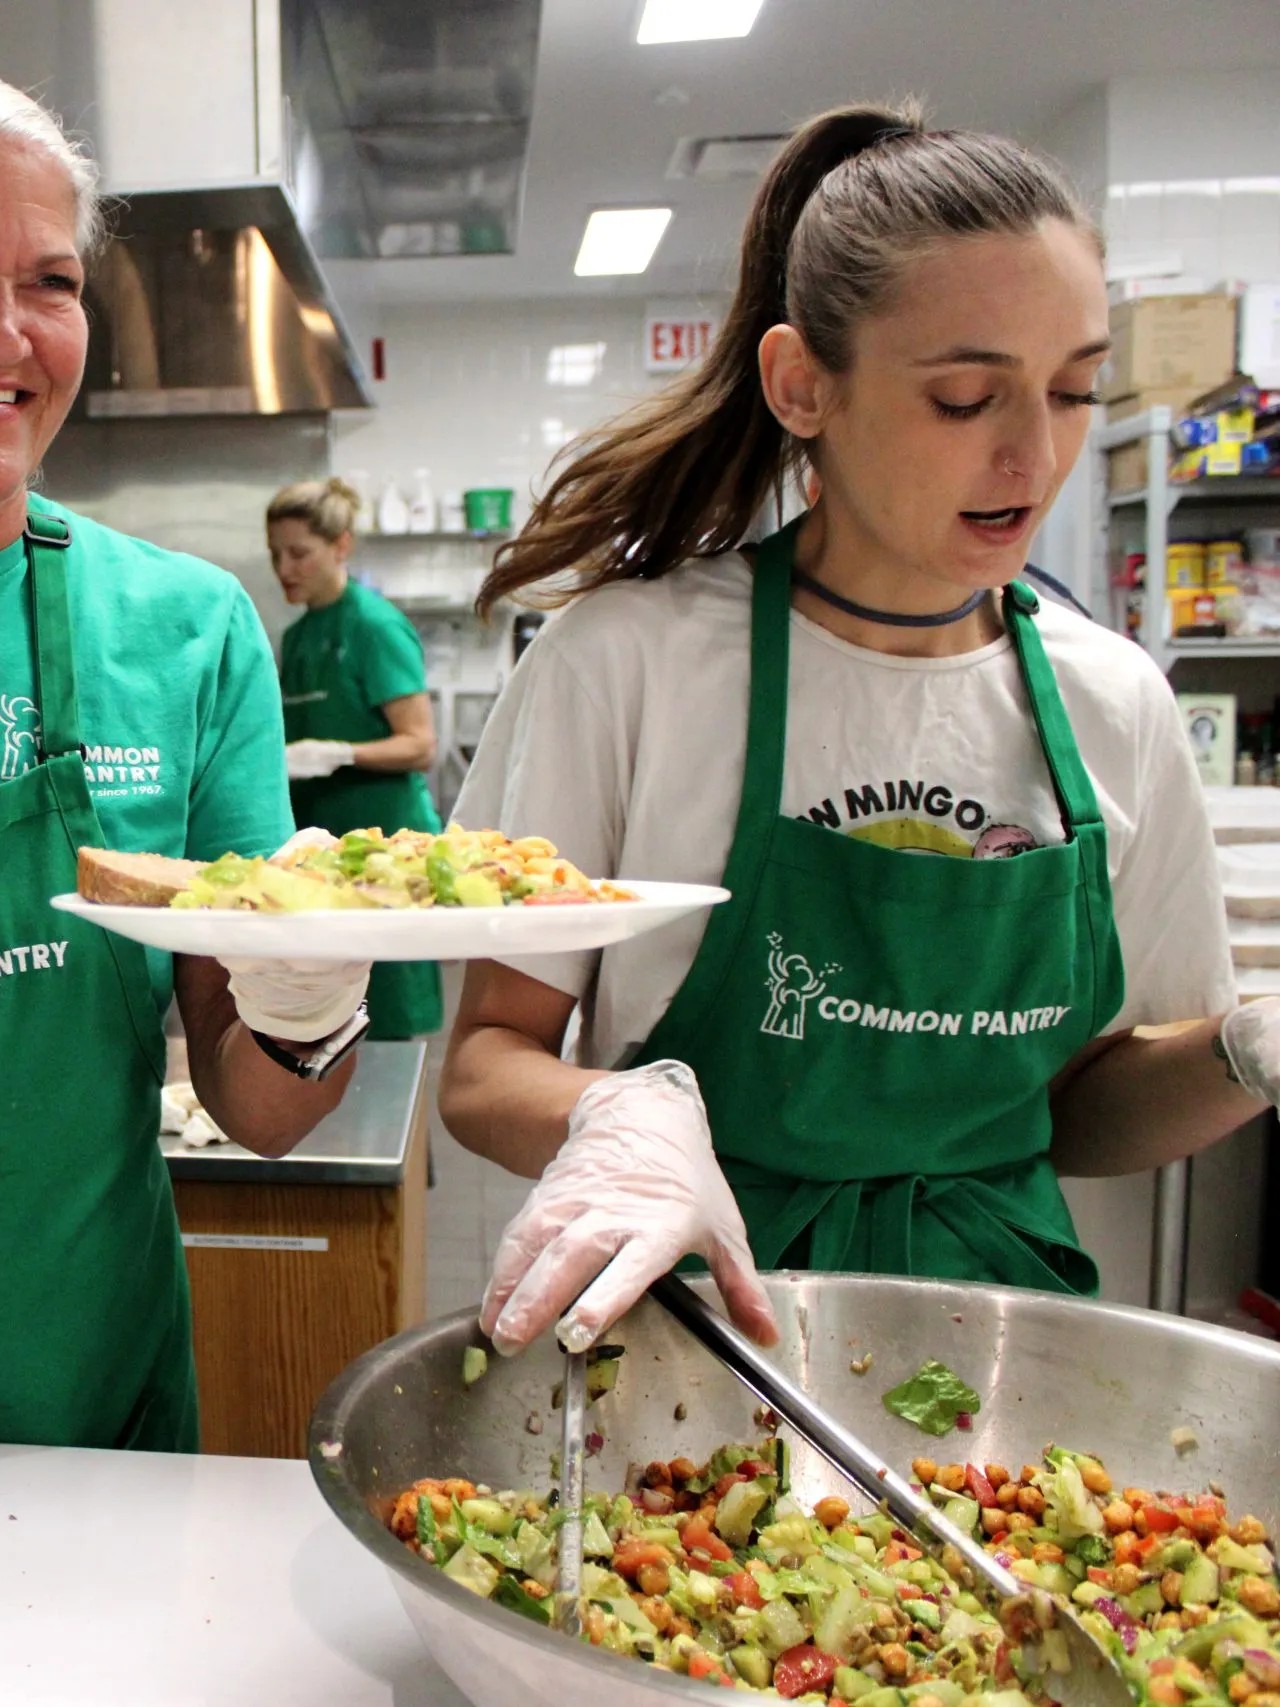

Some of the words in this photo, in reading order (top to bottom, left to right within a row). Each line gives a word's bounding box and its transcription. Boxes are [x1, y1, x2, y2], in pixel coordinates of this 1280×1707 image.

[651, 323, 713, 361] EXIT
[84, 746, 160, 765] MMON
[83, 766, 160, 783] ANTRY
[97, 788, 128, 797] since
[796, 799, 841, 829] N
[844, 780, 985, 831] MINGO
[818, 996, 963, 1036] COMMON
[971, 1006, 1071, 1036] PANTRY
